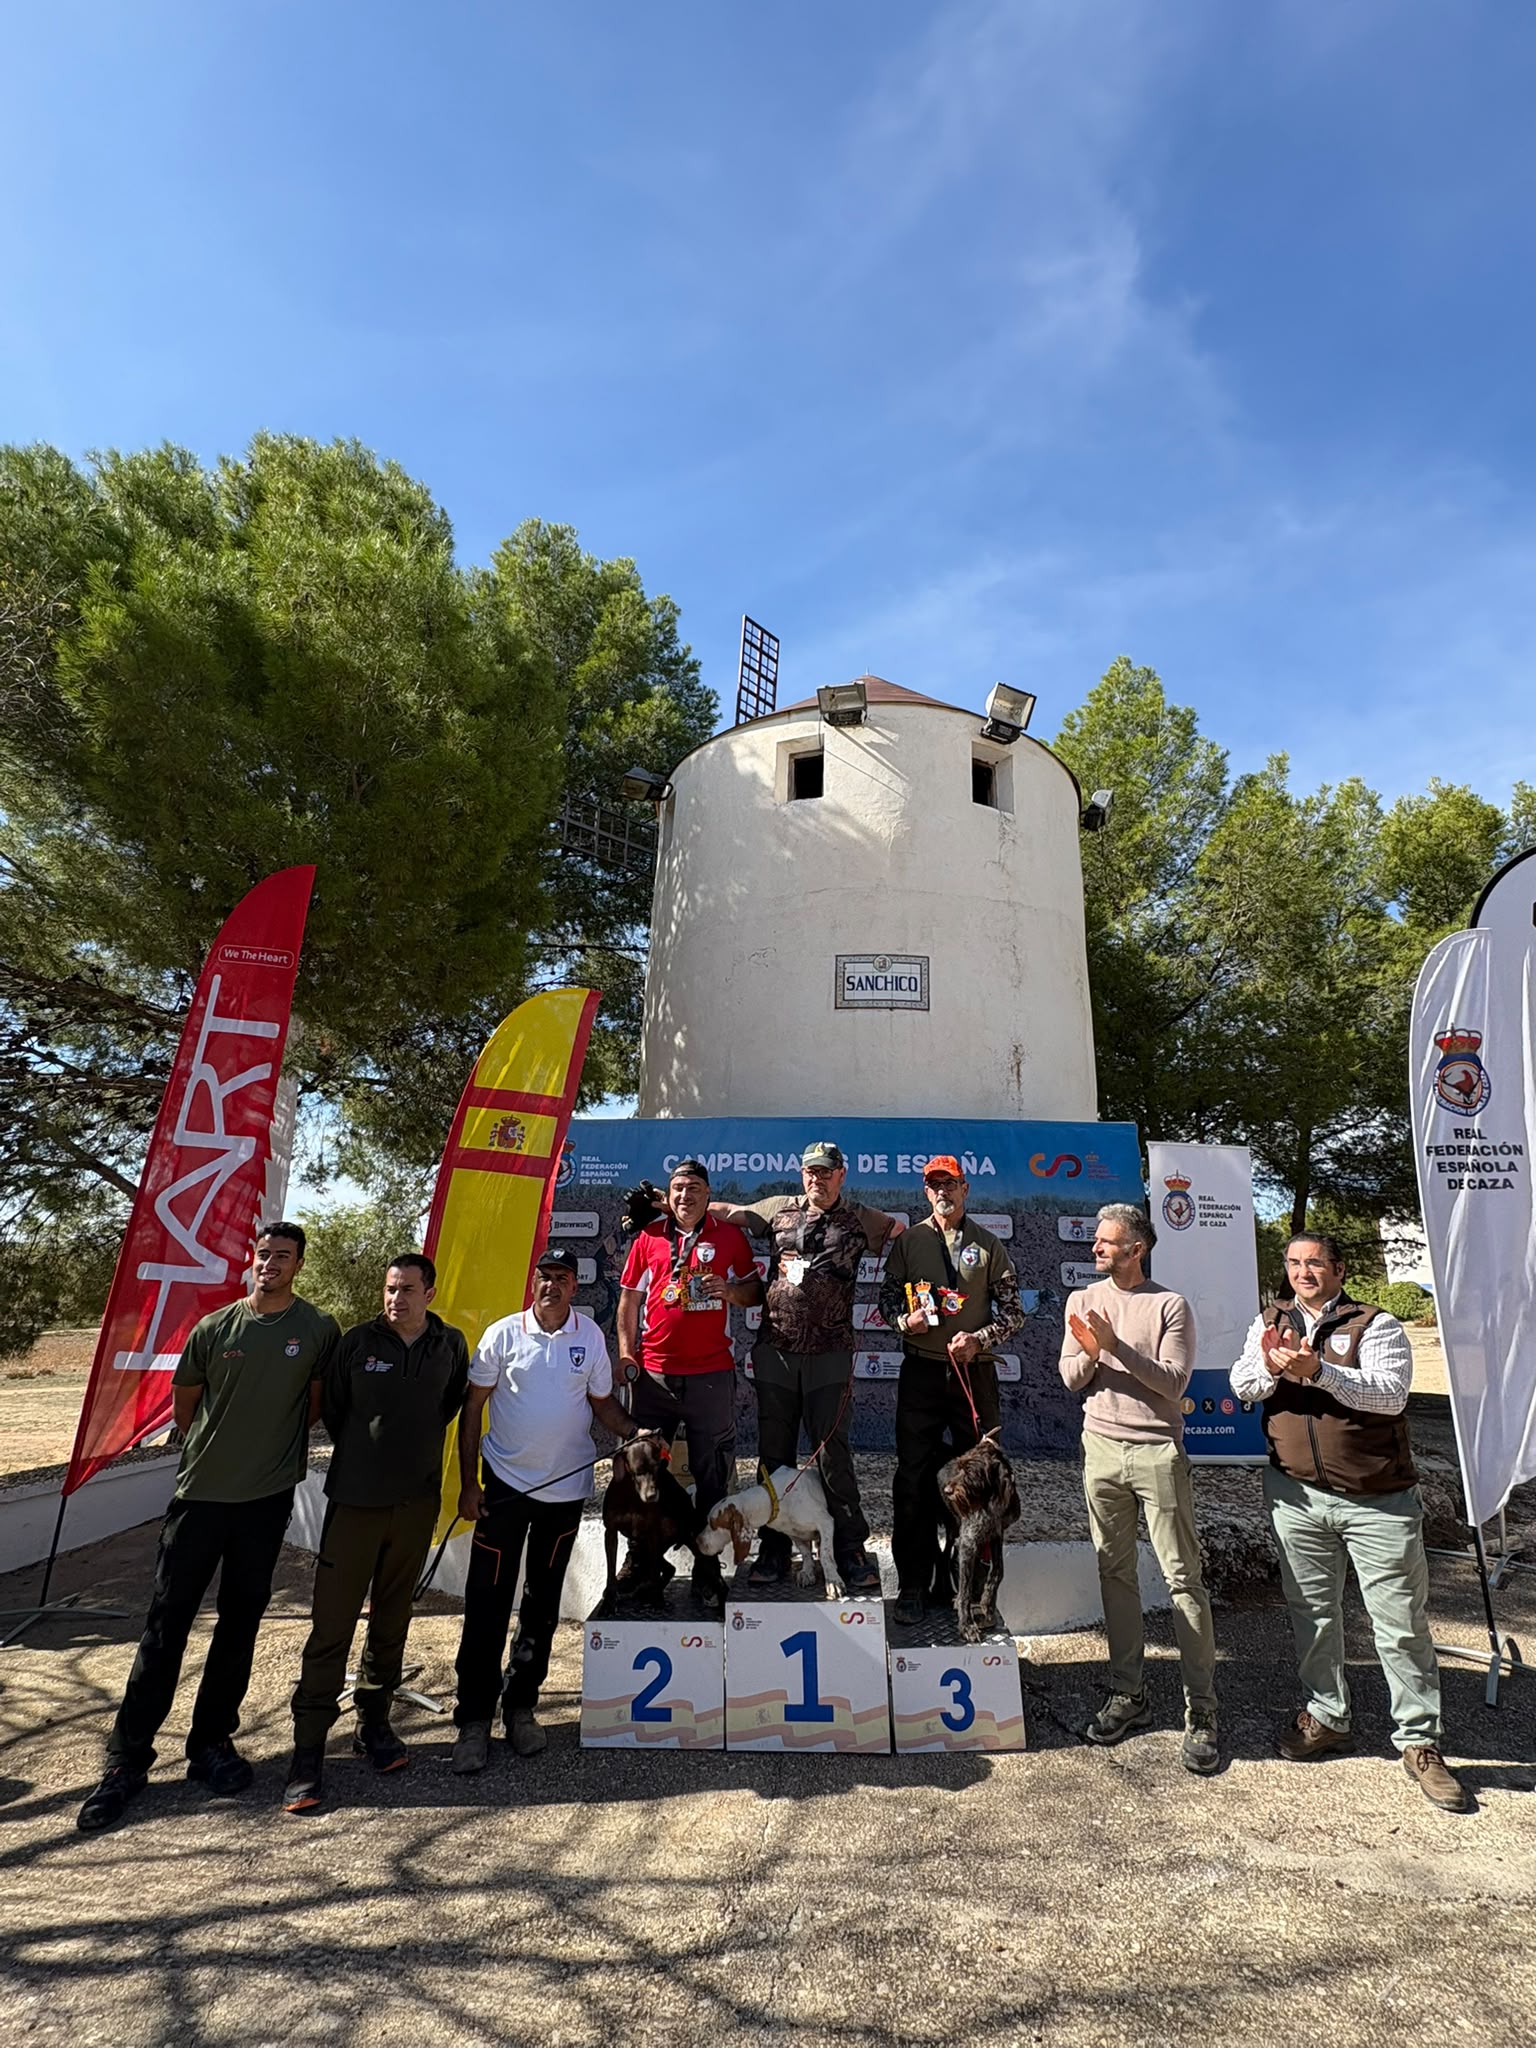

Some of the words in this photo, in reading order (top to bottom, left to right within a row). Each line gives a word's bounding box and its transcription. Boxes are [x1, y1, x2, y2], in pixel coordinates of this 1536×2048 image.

[224, 948, 239, 958] We
[241, 950, 257, 960] The
[258, 951, 288, 964] Heart
[846, 975, 918, 992] SANCHICO
[1453, 1128, 1487, 1140] REAL
[1426, 1141, 1524, 1156] FEDERACIÓN
[580, 1162, 629, 1170] FEDERACIÓN
[857, 1153, 889, 1174] DE
[896, 1150, 997, 1176] ESÑA
[1437, 1159, 1519, 1173] ESPAÑOLA
[113, 974, 280, 1371] HART
[1447, 1178, 1465, 1190] DE
[1467, 1178, 1515, 1190] CAZA
[1198, 1203, 1241, 1212] FEDERACIÓN
[1199, 1211, 1234, 1219] ESPAÑOLA
[1182, 1425, 1236, 1435] ecaza.com
[631, 1646, 673, 1722] 2
[779, 1631, 834, 1722] 1
[939, 1667, 976, 1732] 3
